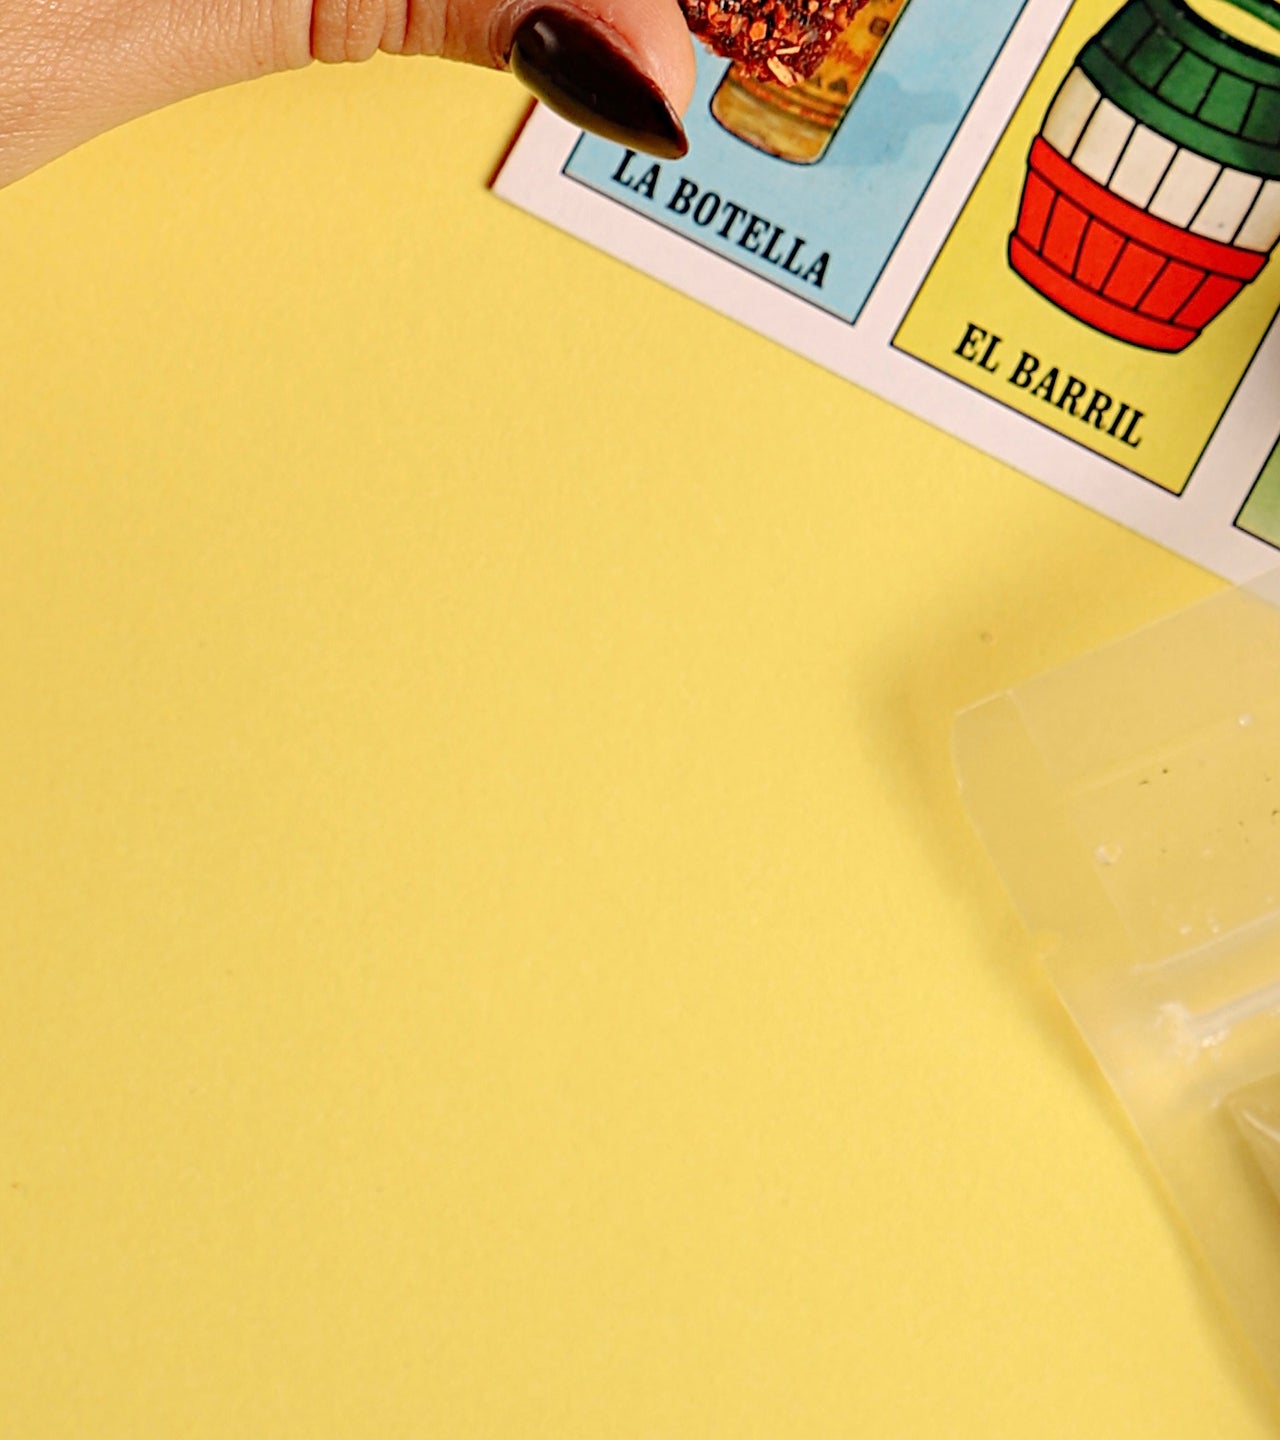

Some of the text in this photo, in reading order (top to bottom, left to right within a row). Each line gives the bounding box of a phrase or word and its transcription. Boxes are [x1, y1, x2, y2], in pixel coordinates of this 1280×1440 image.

[612, 149, 833, 289] LA BOTELLA
[954, 323, 1146, 448] EL BARRIL
